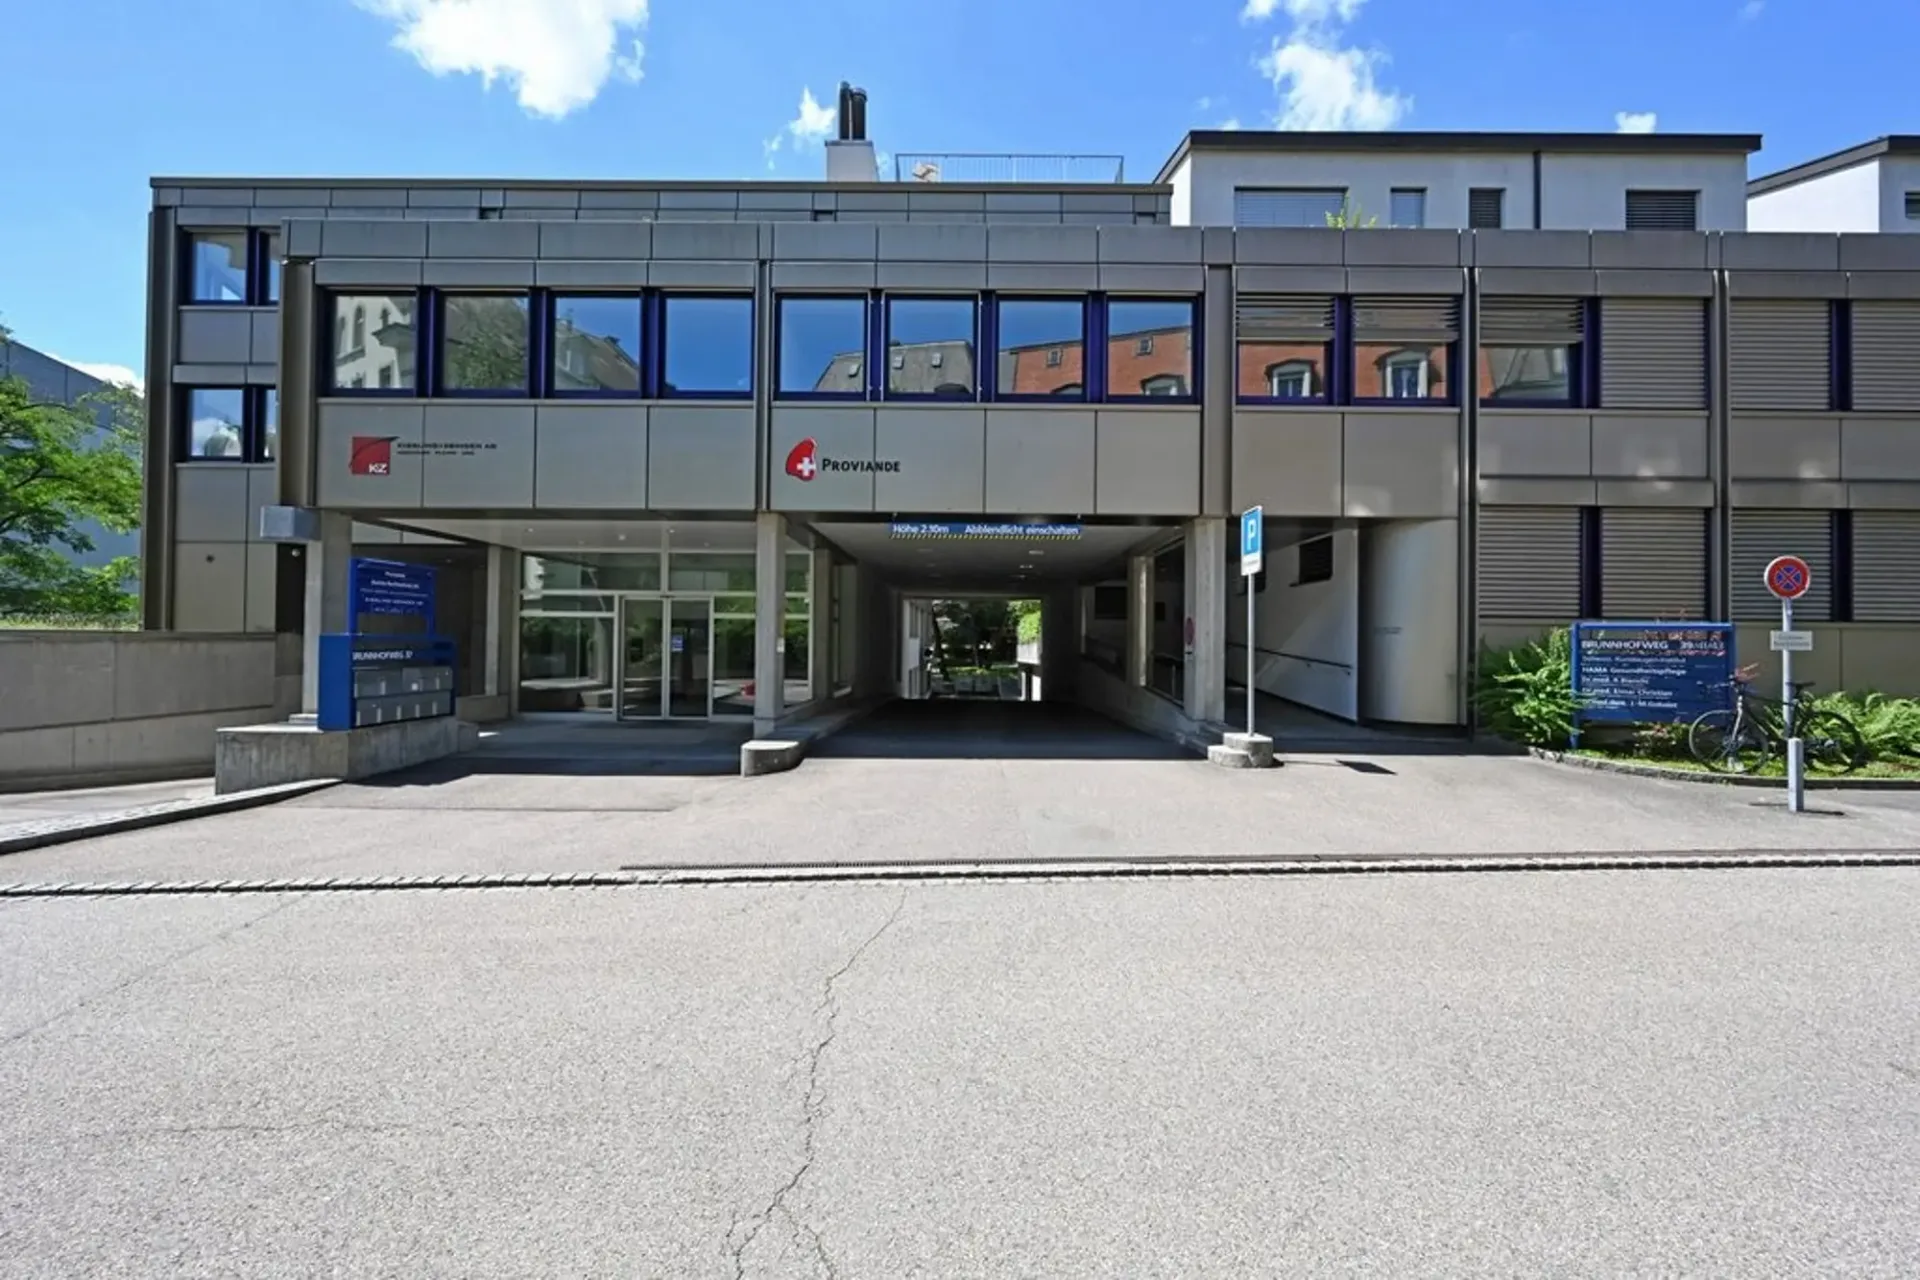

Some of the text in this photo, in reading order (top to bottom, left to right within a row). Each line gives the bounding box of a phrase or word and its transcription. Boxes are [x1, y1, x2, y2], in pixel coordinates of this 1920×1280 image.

[893, 523, 919, 533] Höhe
[965, 524, 1024, 535] Abblendlicht
[1025, 525, 1080, 535] einschalten
[1246, 519, 1257, 550] P
[1581, 640, 1669, 650] BRUNNHOFWEG
